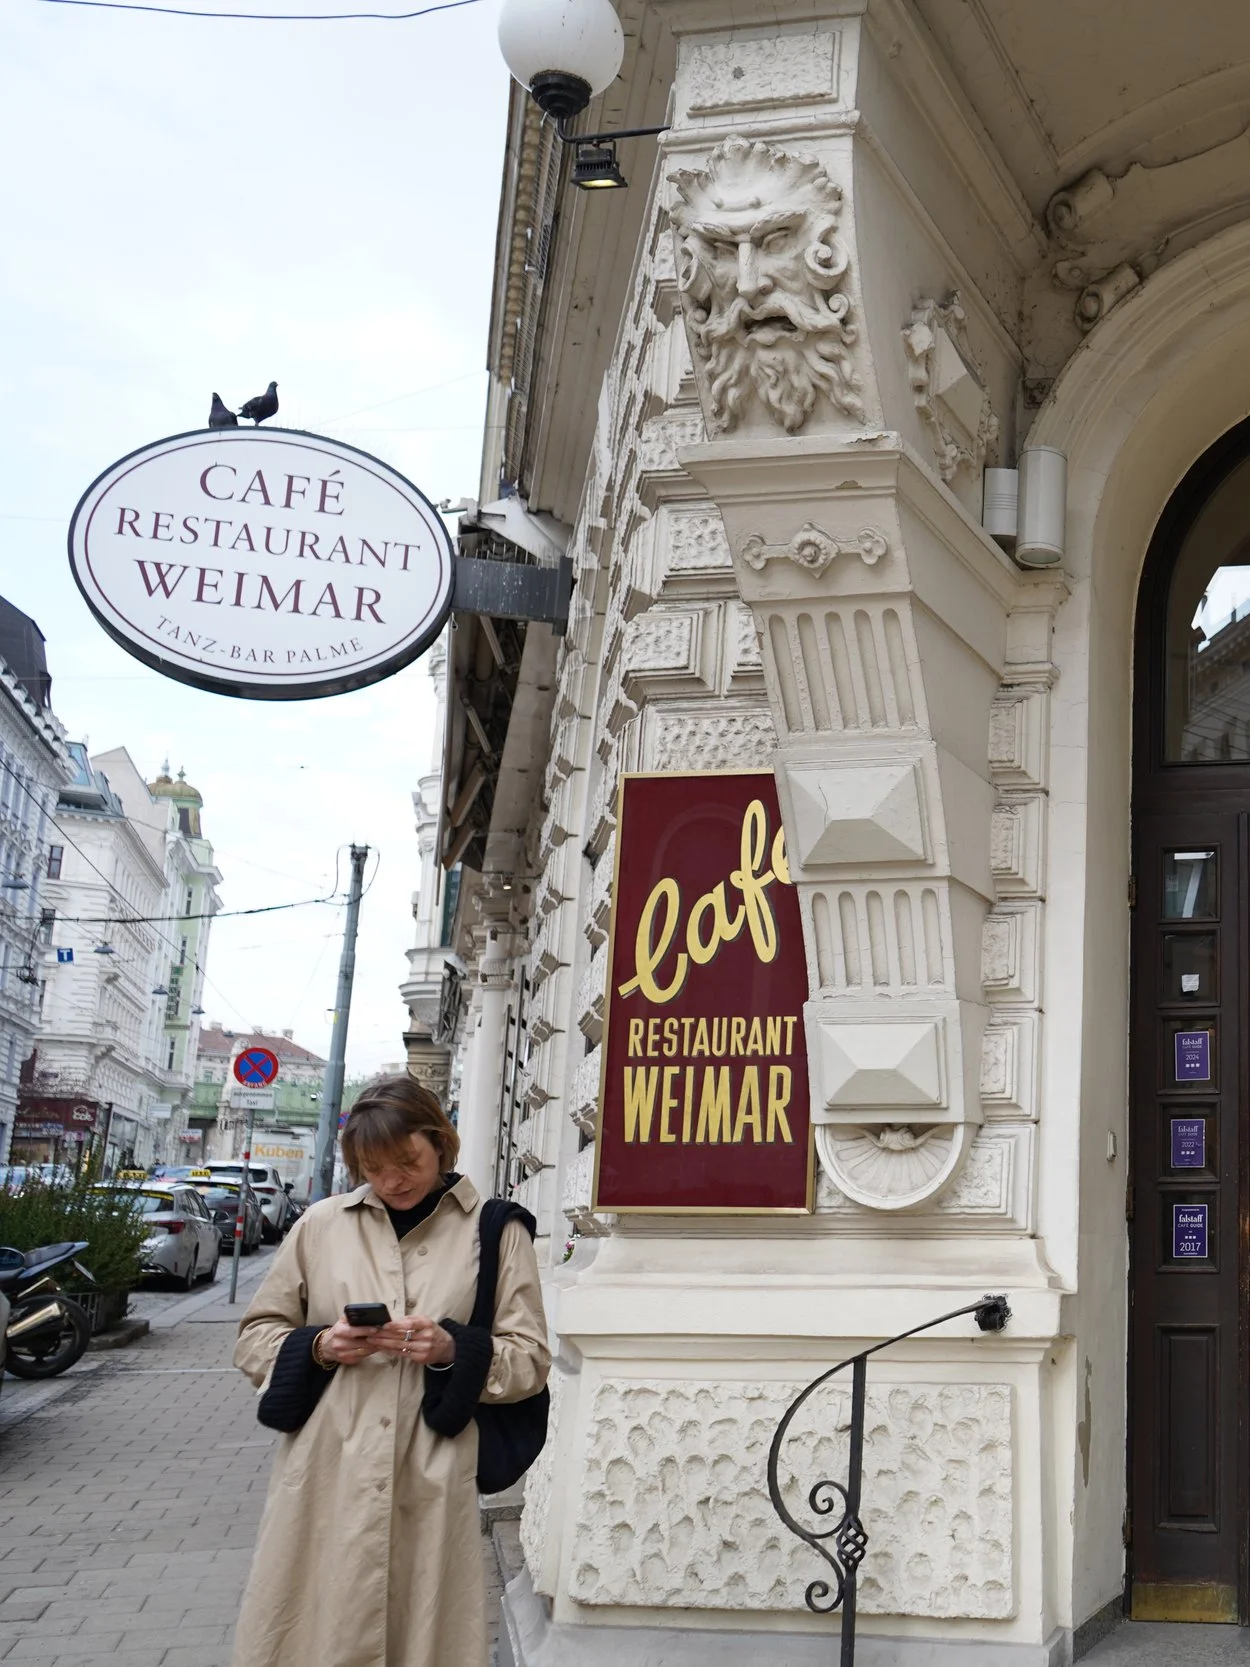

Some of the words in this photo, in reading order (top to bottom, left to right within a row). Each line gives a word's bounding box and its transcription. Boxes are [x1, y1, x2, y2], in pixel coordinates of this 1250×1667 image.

[200, 463, 346, 516] CAFÉ
[114, 507, 421, 572] RESTAURANT
[134, 559, 387, 625] WEIMAR
[156, 615, 275, 664] TANZ-BAR
[286, 637, 364, 664] PALME
[628, 1016, 798, 1057] RESTAURANT
[623, 1066, 793, 1144] WEIMAR
[1179, 1214, 1203, 1222] falstaff
[1180, 1242, 1201, 1251] 2017
